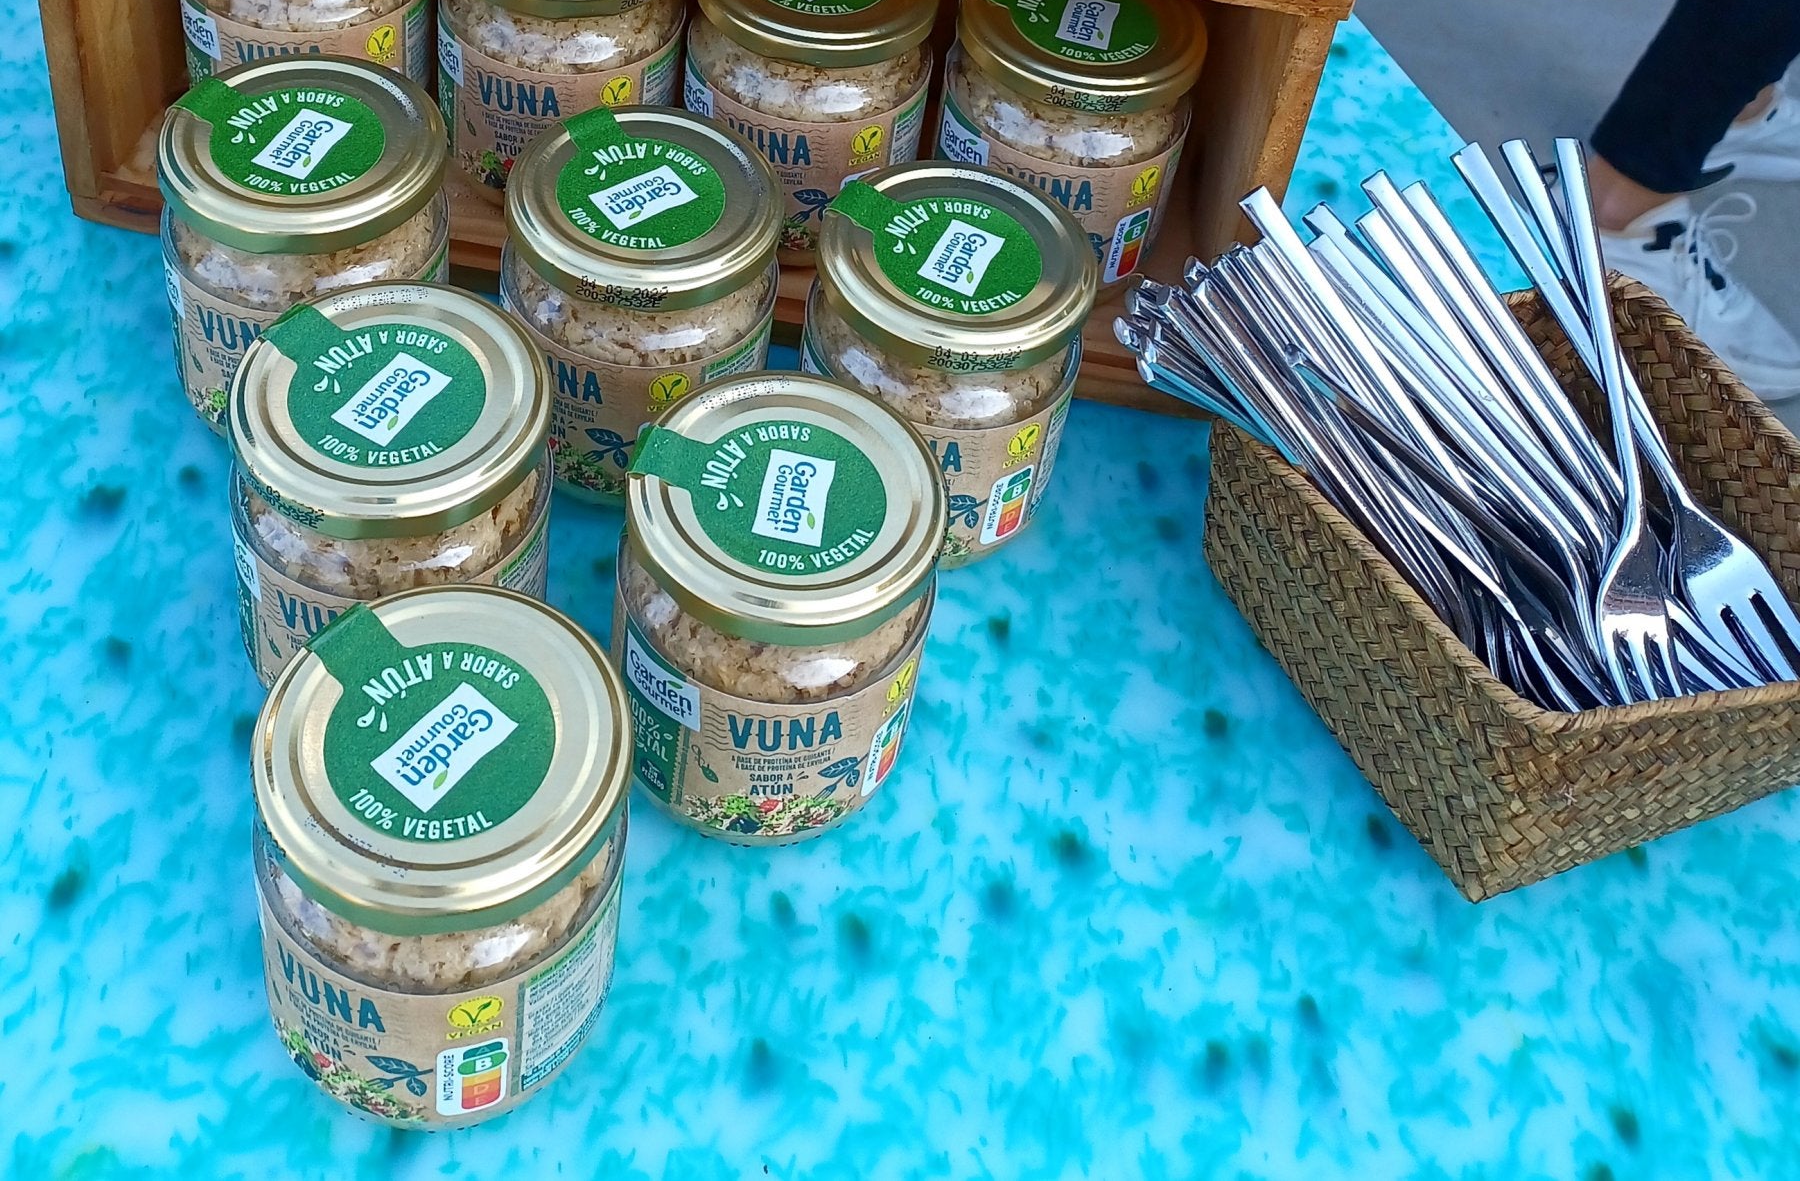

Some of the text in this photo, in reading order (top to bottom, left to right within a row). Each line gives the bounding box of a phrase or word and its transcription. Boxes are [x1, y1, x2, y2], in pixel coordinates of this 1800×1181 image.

[796, 2, 853, 14] VEGETAL
[1077, 1, 1105, 41] Garden
[1060, 42, 1150, 62] 100% VEGETAL
[227, 92, 344, 130] SABOR A ATÚN
[478, 70, 560, 117] VUNA
[1044, 93, 1121, 113] 200307532E
[269, 120, 312, 160] Gourmet
[283, 120, 334, 169] Garden
[592, 143, 707, 176] SABOR A ATÚN
[243, 172, 356, 194] 100% VEGETAL
[608, 176, 665, 203] Gourmet
[609, 181, 681, 215] Garden
[568, 207, 666, 248] 100% VEGETAL
[884, 201, 991, 241] SABOR ATÚN
[932, 232, 967, 271] Gourmet
[942, 233, 987, 284] Garden
[575, 285, 661, 308] 200307532E
[916, 286, 1022, 312] 100% VEGETAL
[312, 330, 448, 375] SABOR ATÚN
[927, 356, 1014, 370] 200307532E
[352, 367, 409, 416] Gourmet
[358, 370, 431, 430] Garden
[317, 434, 443, 465] 100% VEGETAL
[700, 425, 811, 490] SABOR ATÚN
[766, 464, 793, 525] Gourmet
[783, 461, 817, 534] Garden
[1013, 485, 1023, 496] B
[757, 527, 876, 570] 100% VEGETAL
[361, 651, 520, 707] SABOR A ATÚN
[630, 650, 692, 713] Garden
[634, 671, 687, 718] Gourmet
[395, 703, 469, 765] Gourmet
[405, 707, 493, 786] Garden
[727, 711, 843, 752] VUNA
[749, 772, 783, 783] SABOR
[750, 781, 794, 796] ATÚN
[349, 787, 493, 840] 100% VEGETAL
[277, 938, 386, 1033] VUNA
[474, 1056, 492, 1070] B
